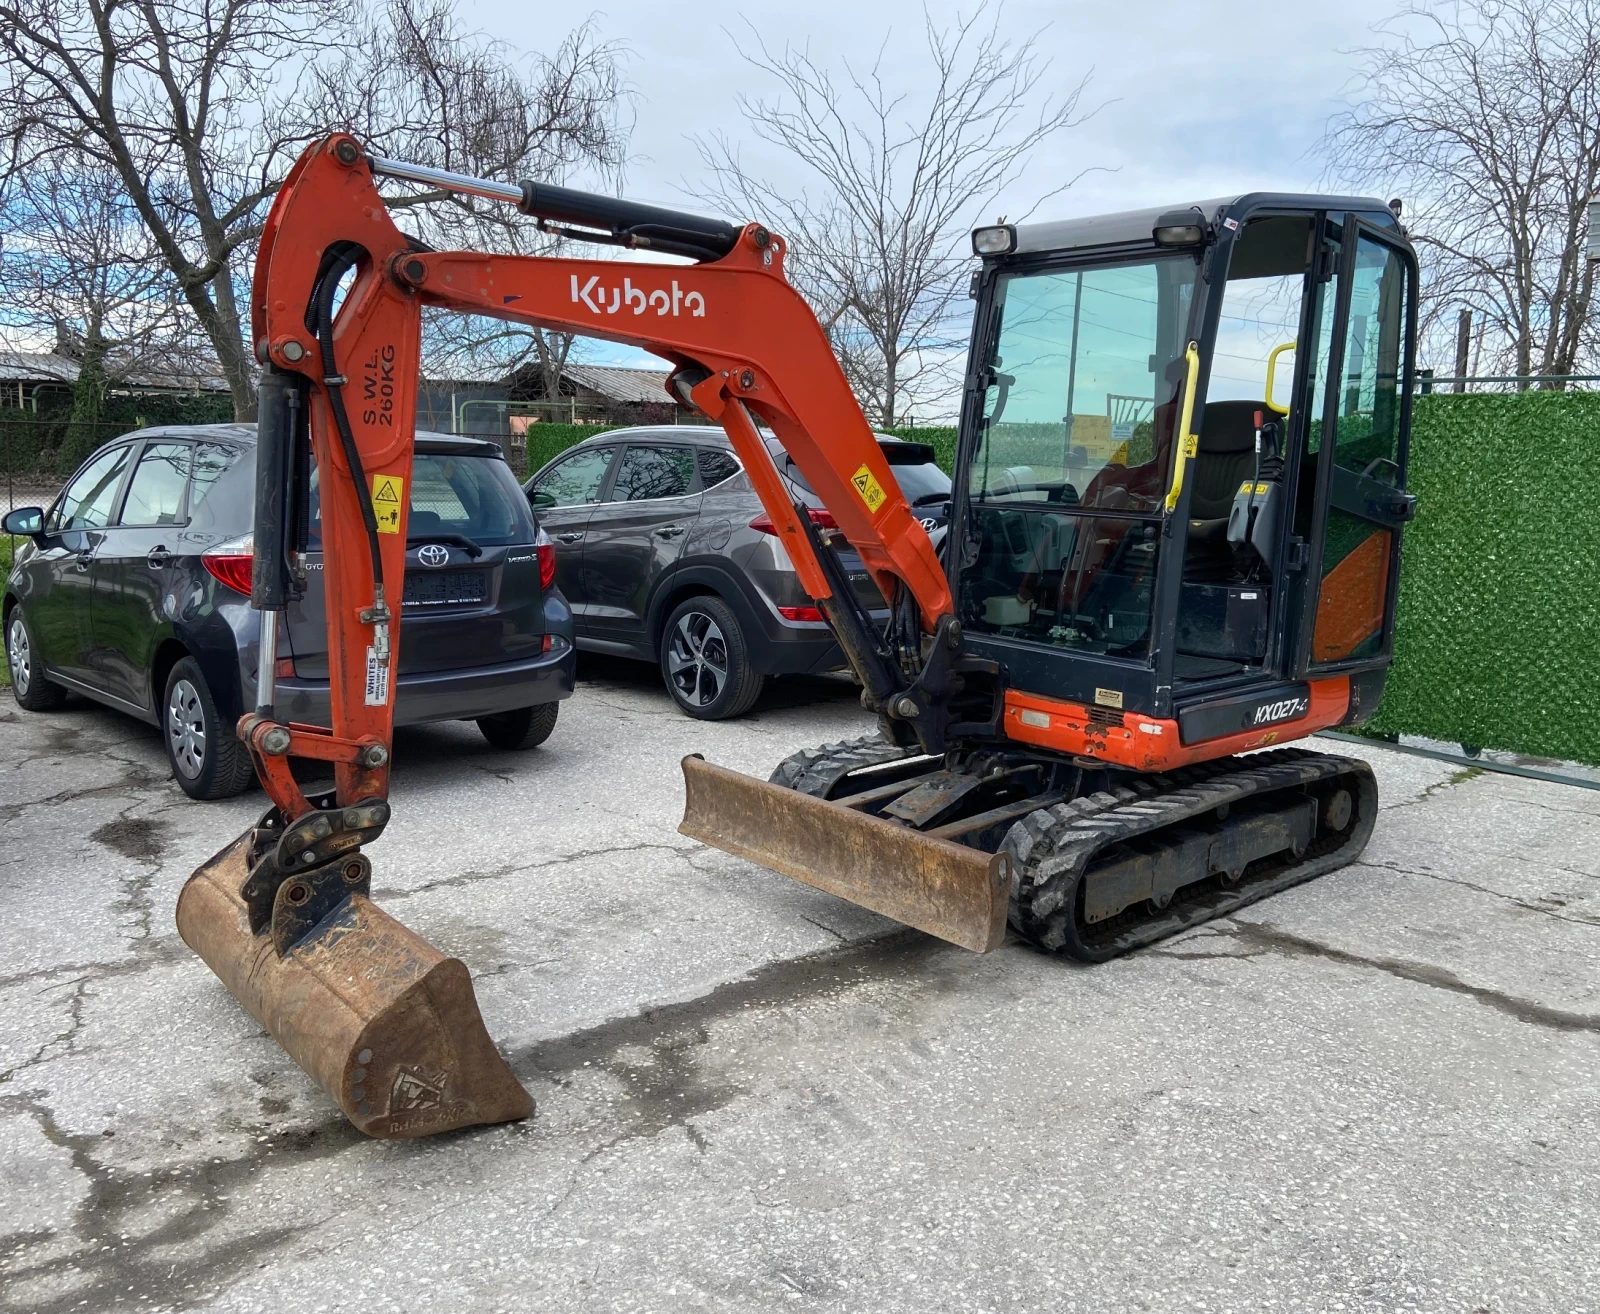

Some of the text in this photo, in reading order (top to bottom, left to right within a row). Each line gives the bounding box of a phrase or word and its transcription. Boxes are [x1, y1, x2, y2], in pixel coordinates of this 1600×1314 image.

[570, 274, 705, 317] Kubota
[363, 348, 378, 426] S.W.L.
[380, 344, 395, 427] 260KG
[367, 657, 377, 695] WHITES
